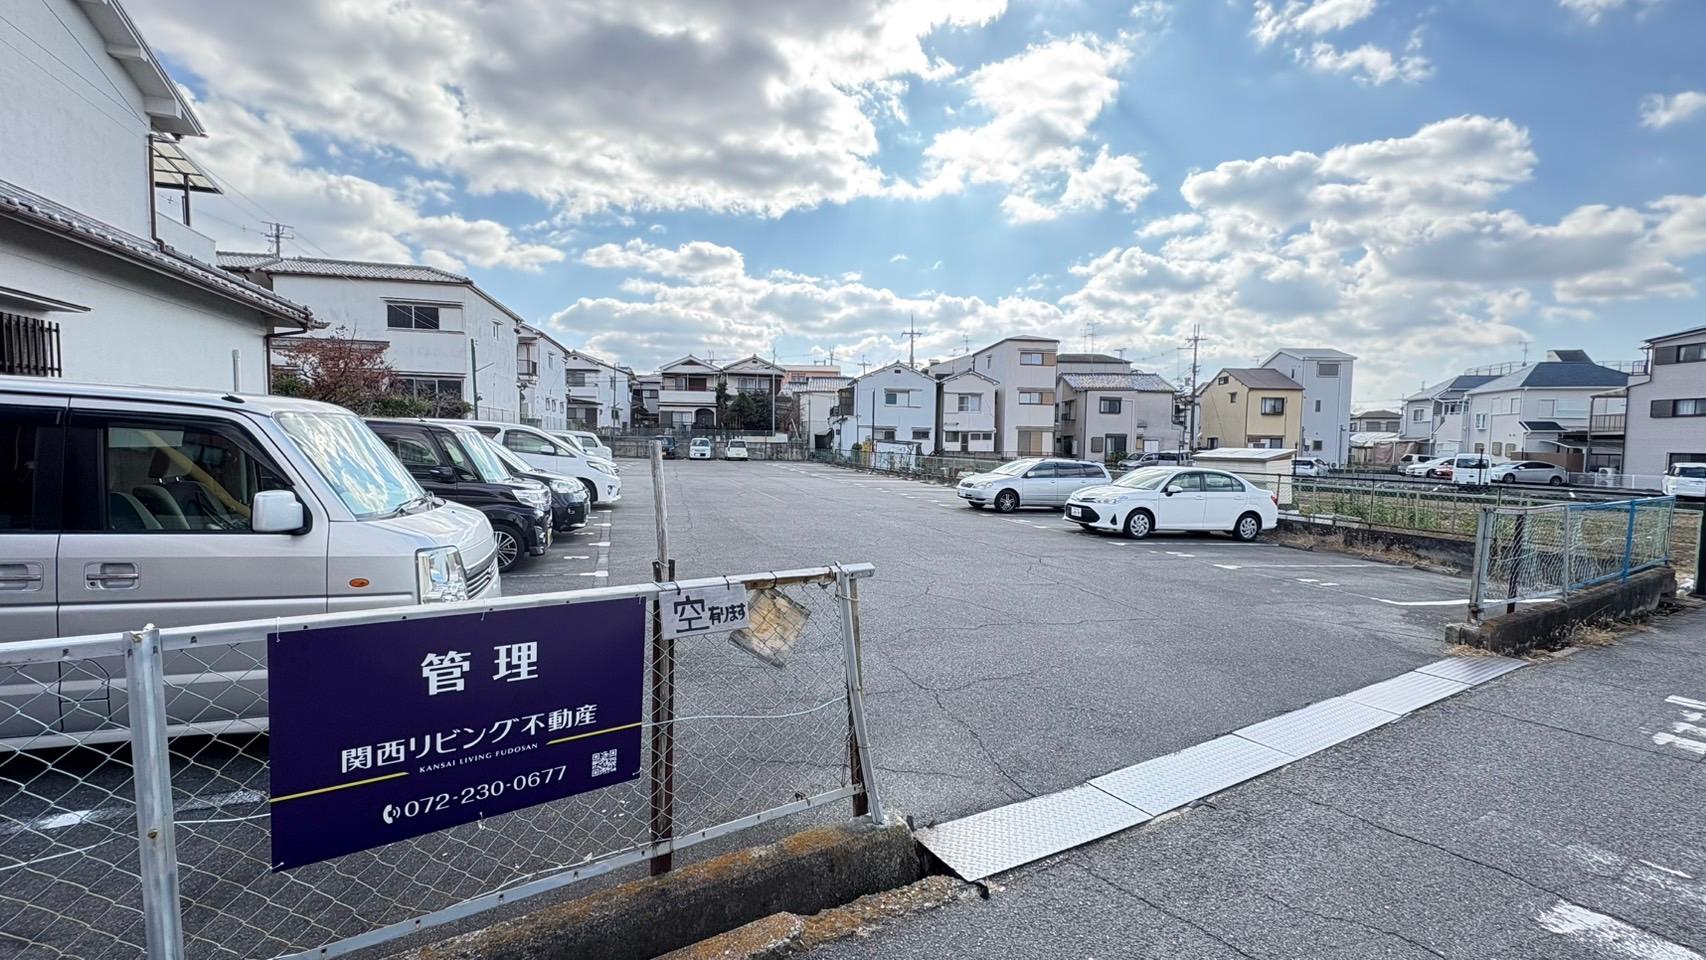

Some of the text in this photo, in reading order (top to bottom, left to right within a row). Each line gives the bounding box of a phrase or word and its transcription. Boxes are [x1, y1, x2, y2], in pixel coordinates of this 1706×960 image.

[341, 704, 598, 774] 関西リビング不動産
[419, 742, 538, 773] KANSAI LIVING FUDOSAN
[404, 765, 567, 818] 072-230-0677
